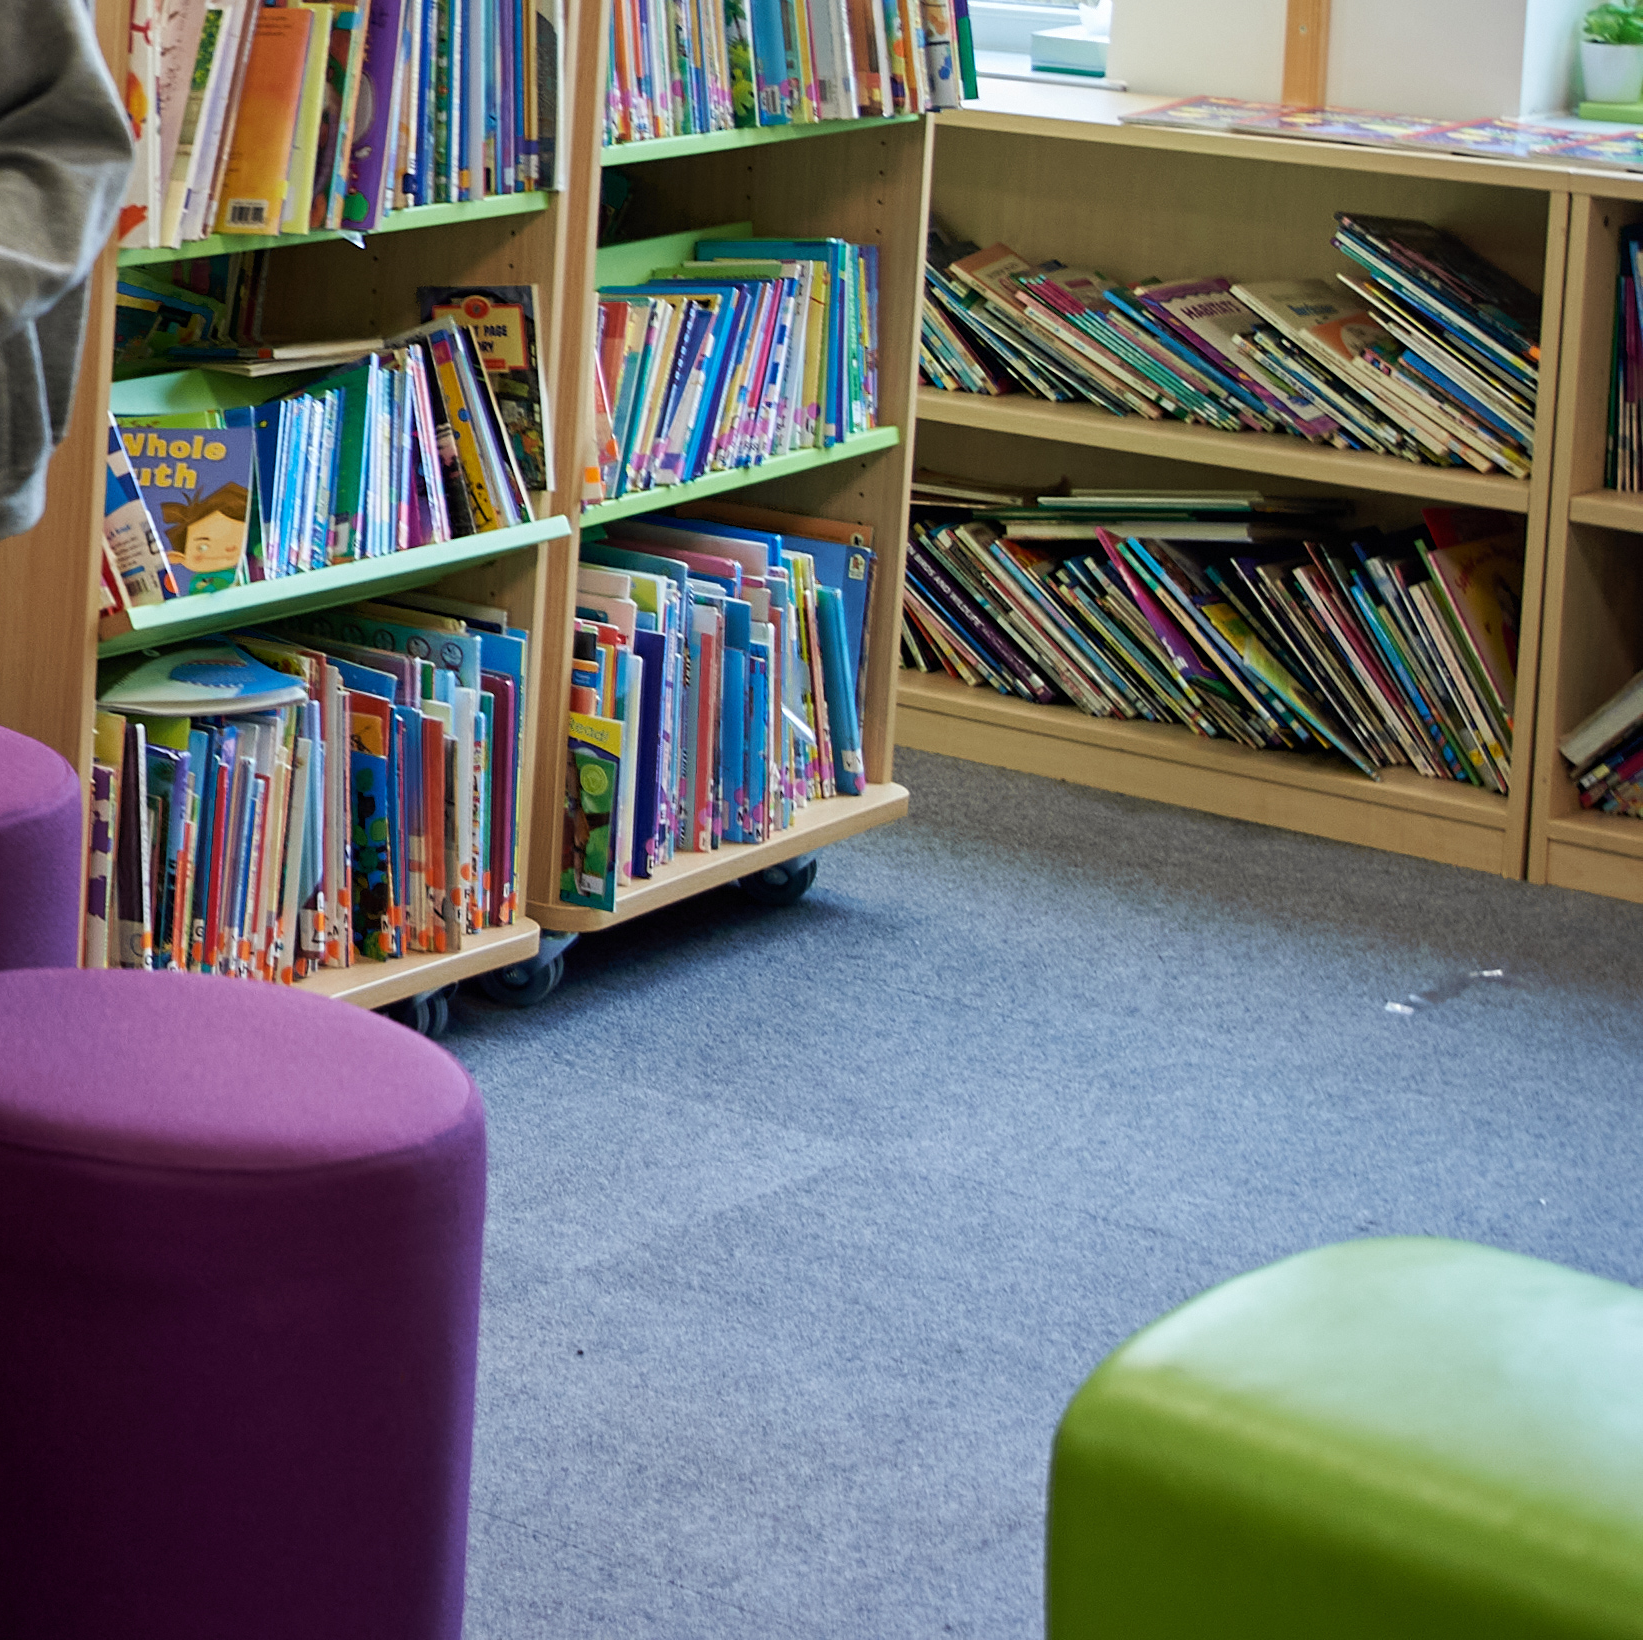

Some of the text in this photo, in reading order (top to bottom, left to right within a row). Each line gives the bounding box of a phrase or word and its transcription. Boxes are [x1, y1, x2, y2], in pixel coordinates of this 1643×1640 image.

[1180, 299, 1242, 321] HABITATS
[484, 324, 508, 337] PAGE
[121, 432, 227, 461] Whole
[135, 461, 197, 490] uth
[934, 571, 950, 592] AND
